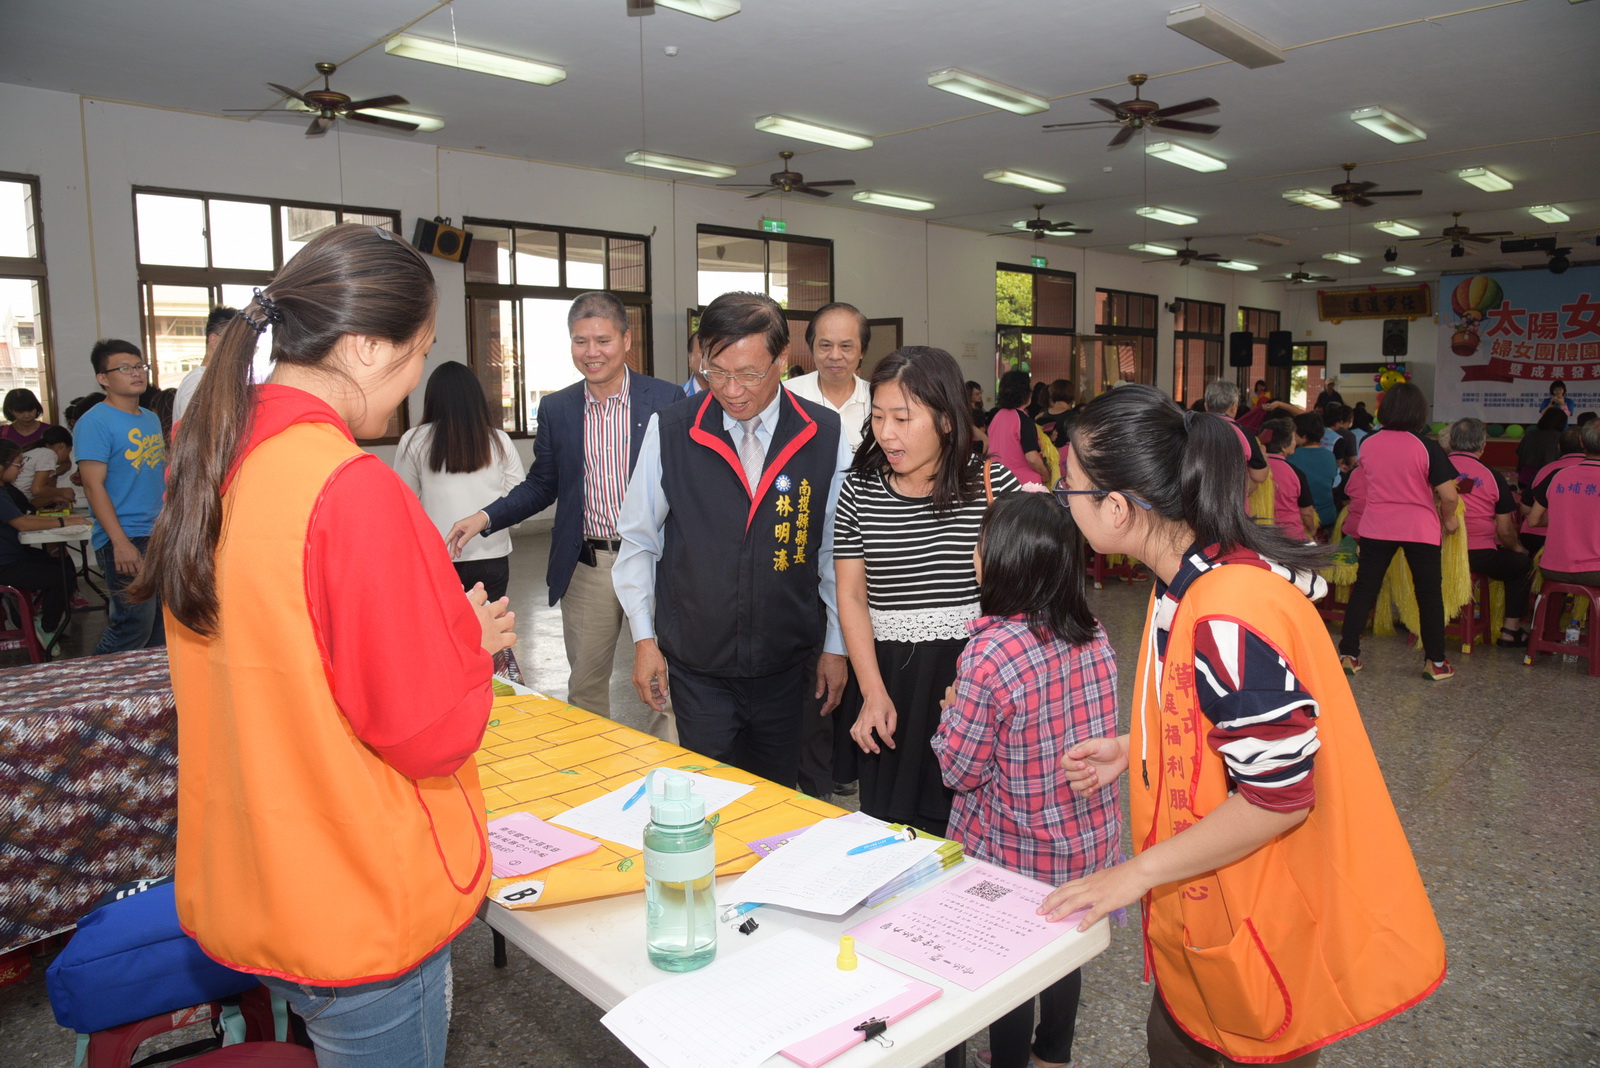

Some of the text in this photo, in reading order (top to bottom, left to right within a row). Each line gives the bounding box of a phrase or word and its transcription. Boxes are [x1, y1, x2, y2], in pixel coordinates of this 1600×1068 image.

[1555, 482, 1600, 497] 南埔樂
[773, 494, 795, 572] 林明溱
[793, 478, 812, 564] 南投縣縣長
[503, 887, 538, 902] B
